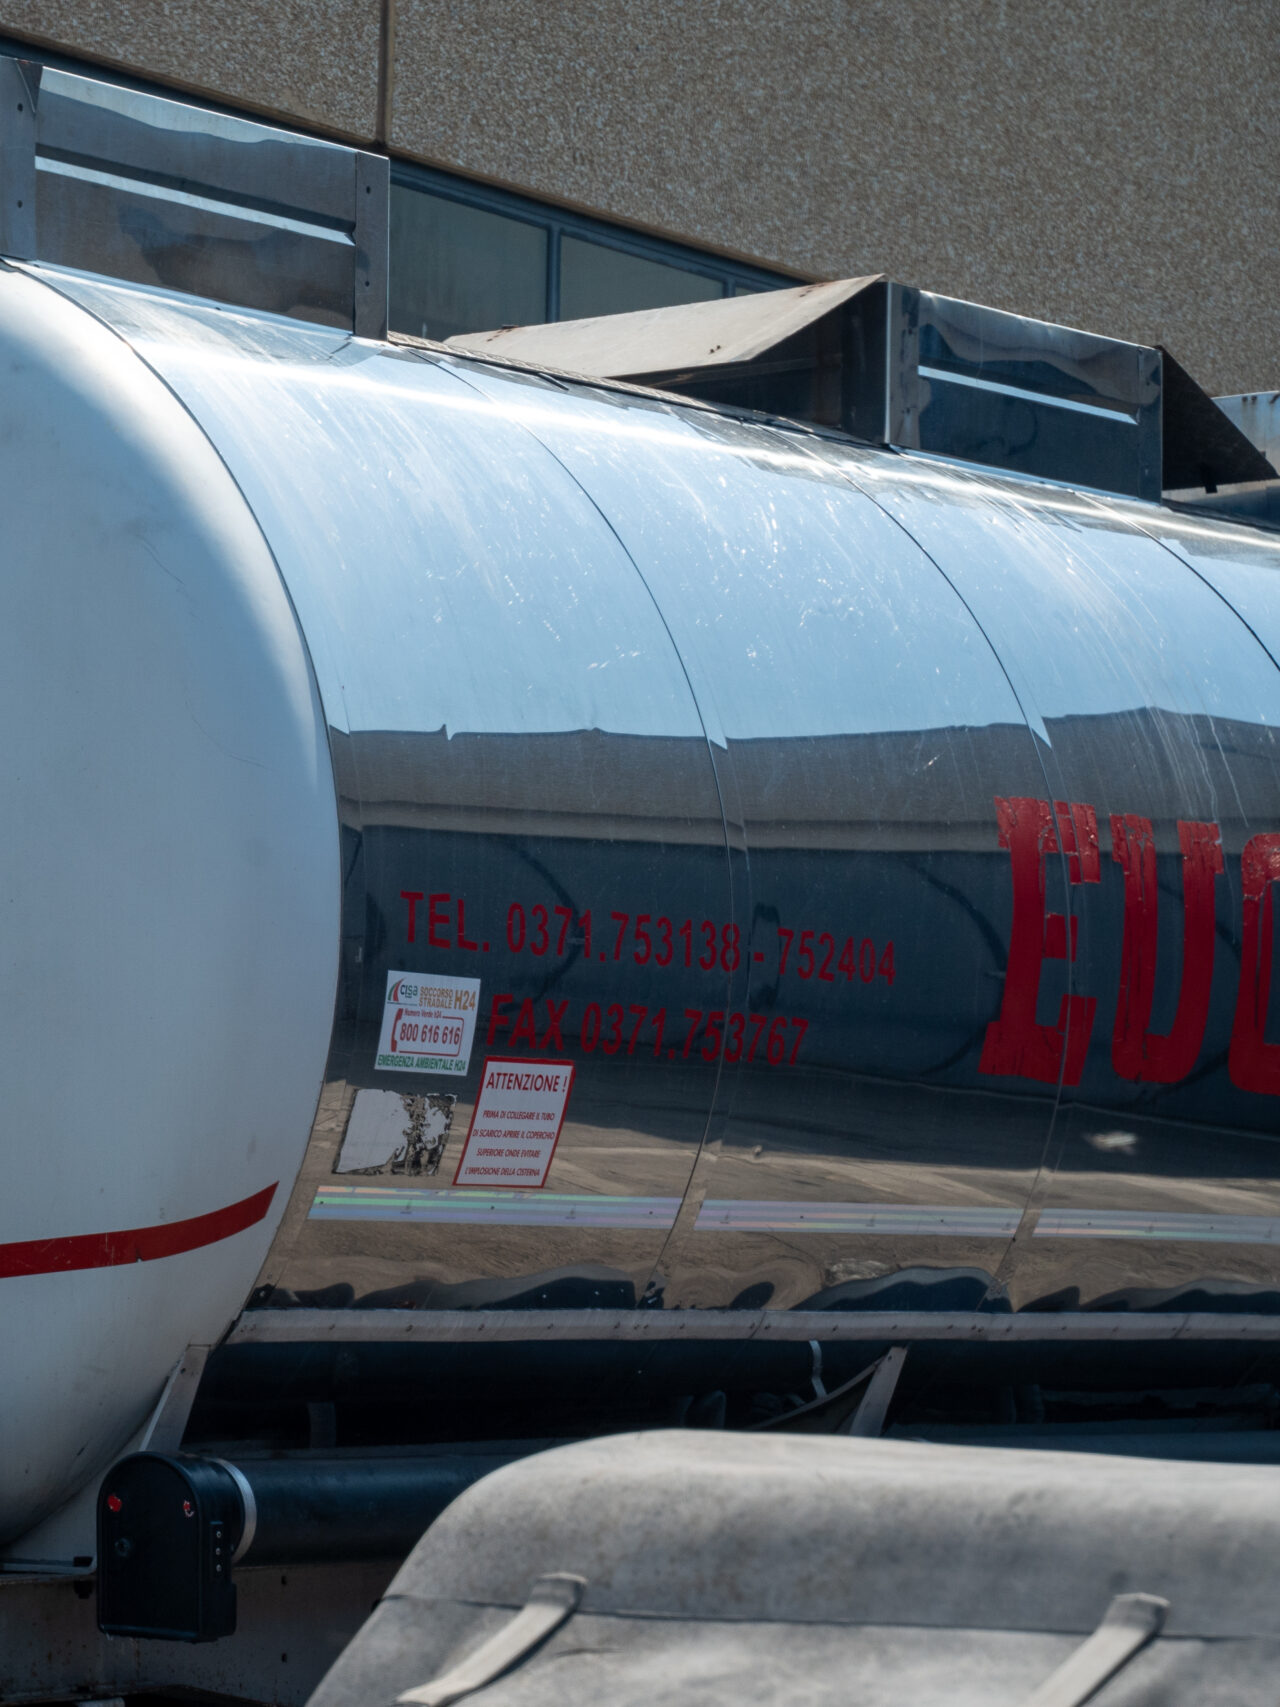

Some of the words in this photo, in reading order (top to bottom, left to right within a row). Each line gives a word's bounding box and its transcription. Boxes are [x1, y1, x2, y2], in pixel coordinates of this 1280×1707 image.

[400, 891, 490, 951] TEL.
[506, 902, 740, 974] 0371.753138
[777, 928, 897, 985] 752404
[419, 997, 453, 1010] STRADALE
[454, 990, 477, 1011] H24
[420, 986, 453, 998] SOCCORSO
[400, 1023, 419, 1042] 800
[421, 1024, 440, 1044] 616
[441, 1026, 460, 1046] 616
[486, 994, 571, 1052] FAX
[581, 1003, 810, 1066] 0371.753767
[377, 1054, 414, 1067] EMERGENZA
[414, 1057, 453, 1070] AMBIENTALE
[486, 1072, 560, 1093] ATTENZIONE
[483, 1110, 499, 1119] PRIMA
[479, 1129, 502, 1138] SCARICO
